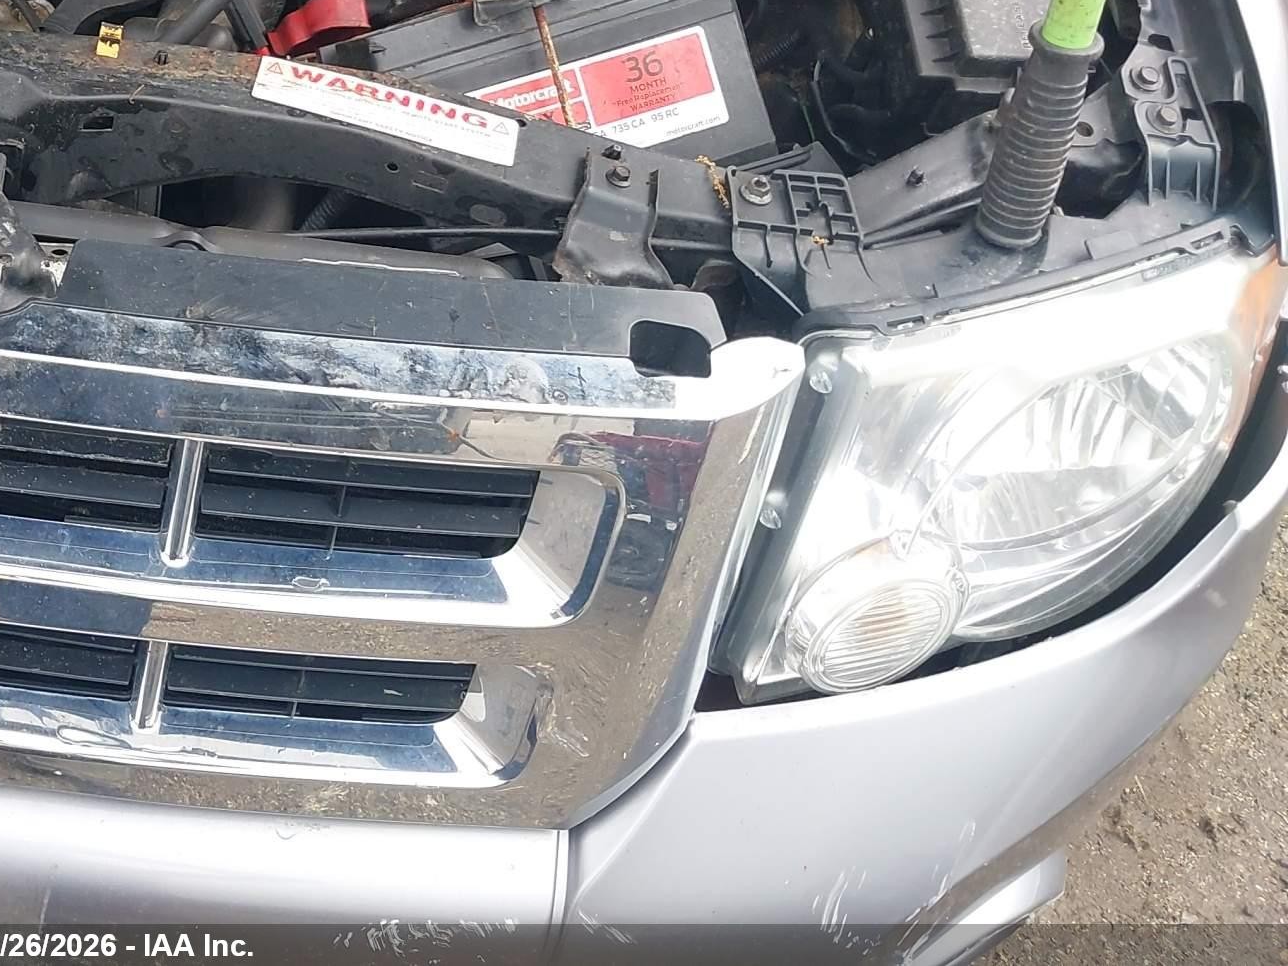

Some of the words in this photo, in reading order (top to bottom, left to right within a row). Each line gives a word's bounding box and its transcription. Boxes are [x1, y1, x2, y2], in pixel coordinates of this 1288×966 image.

[623, 50, 663, 83] 36
[291, 66, 488, 128] WARNING
[630, 76, 667, 94] MONTH
[629, 94, 676, 112] WARRANTY
[612, 122, 631, 135] 735
[631, 119, 646, 129] CA
[651, 112, 664, 123] 95
[665, 107, 680, 119] RC
